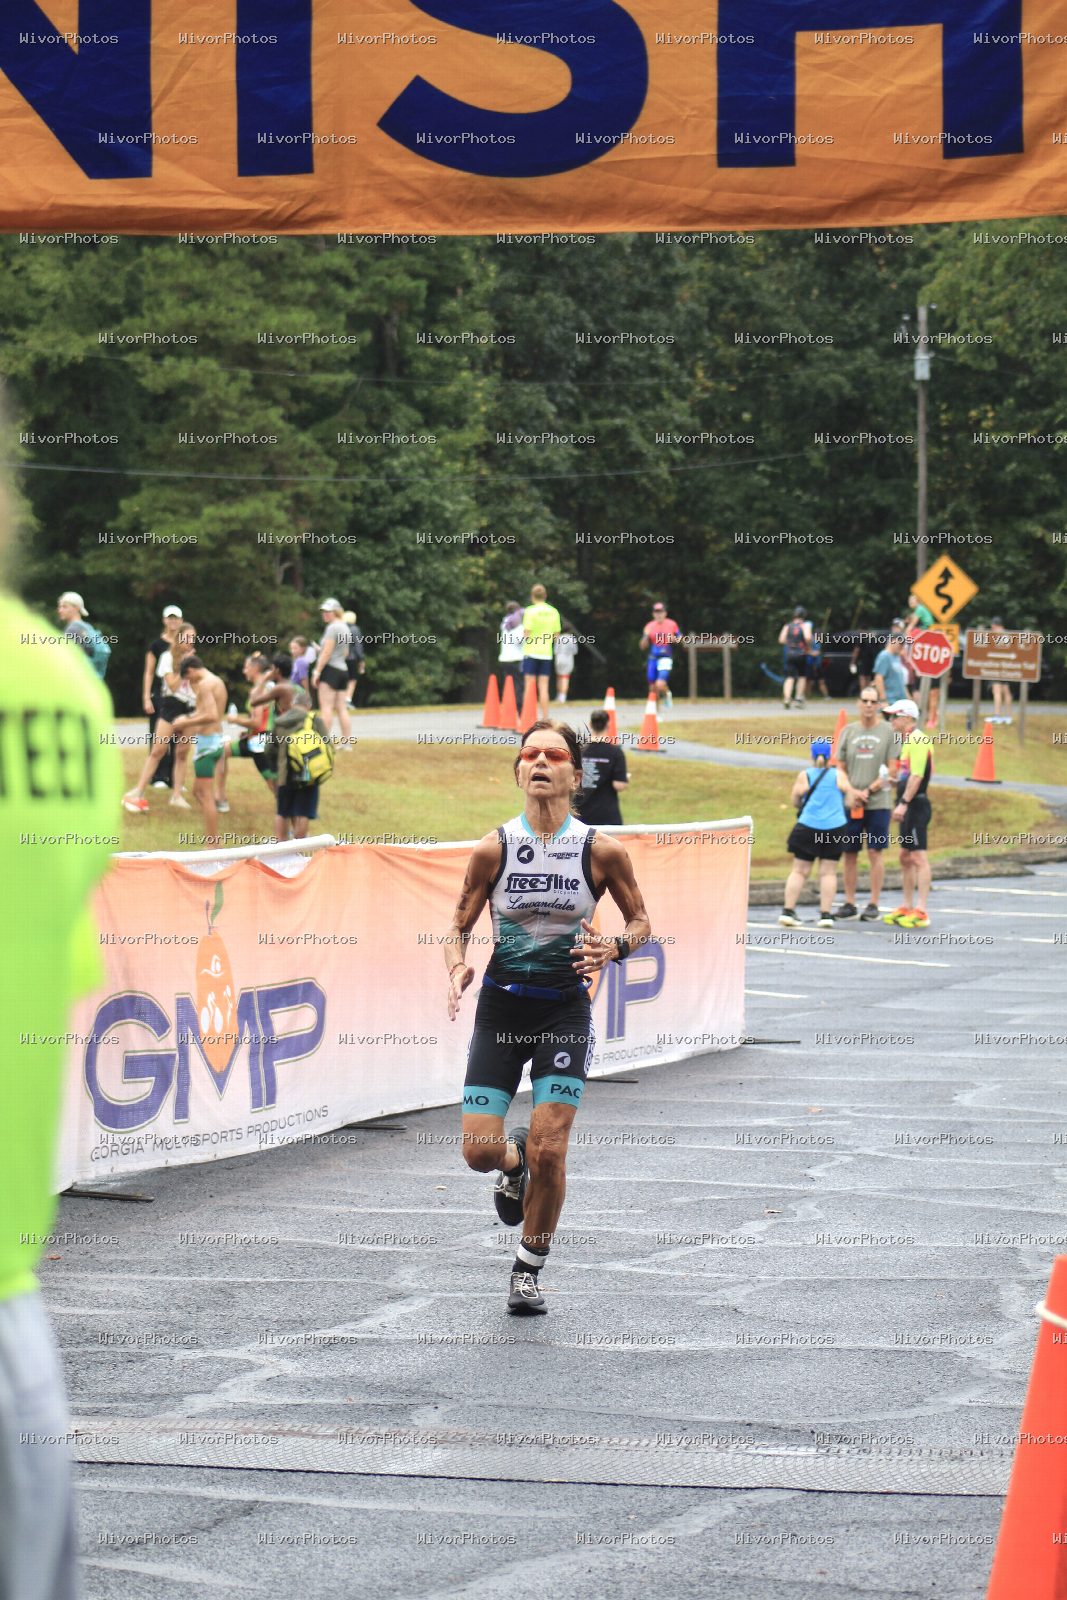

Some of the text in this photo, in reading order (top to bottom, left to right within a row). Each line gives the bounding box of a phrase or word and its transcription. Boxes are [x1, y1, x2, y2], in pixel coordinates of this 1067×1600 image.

[0, 0, 1024, 179] ISH
[912, 642, 951, 665] STOP
[504, 872, 581, 893] free-flite
[506, 895, 576, 912] Lawandales
[83, 976, 328, 1134] GMP
[602, 1044, 664, 1063] PRODUCTIONS
[247, 1104, 329, 1139] PRODUCTIONS
